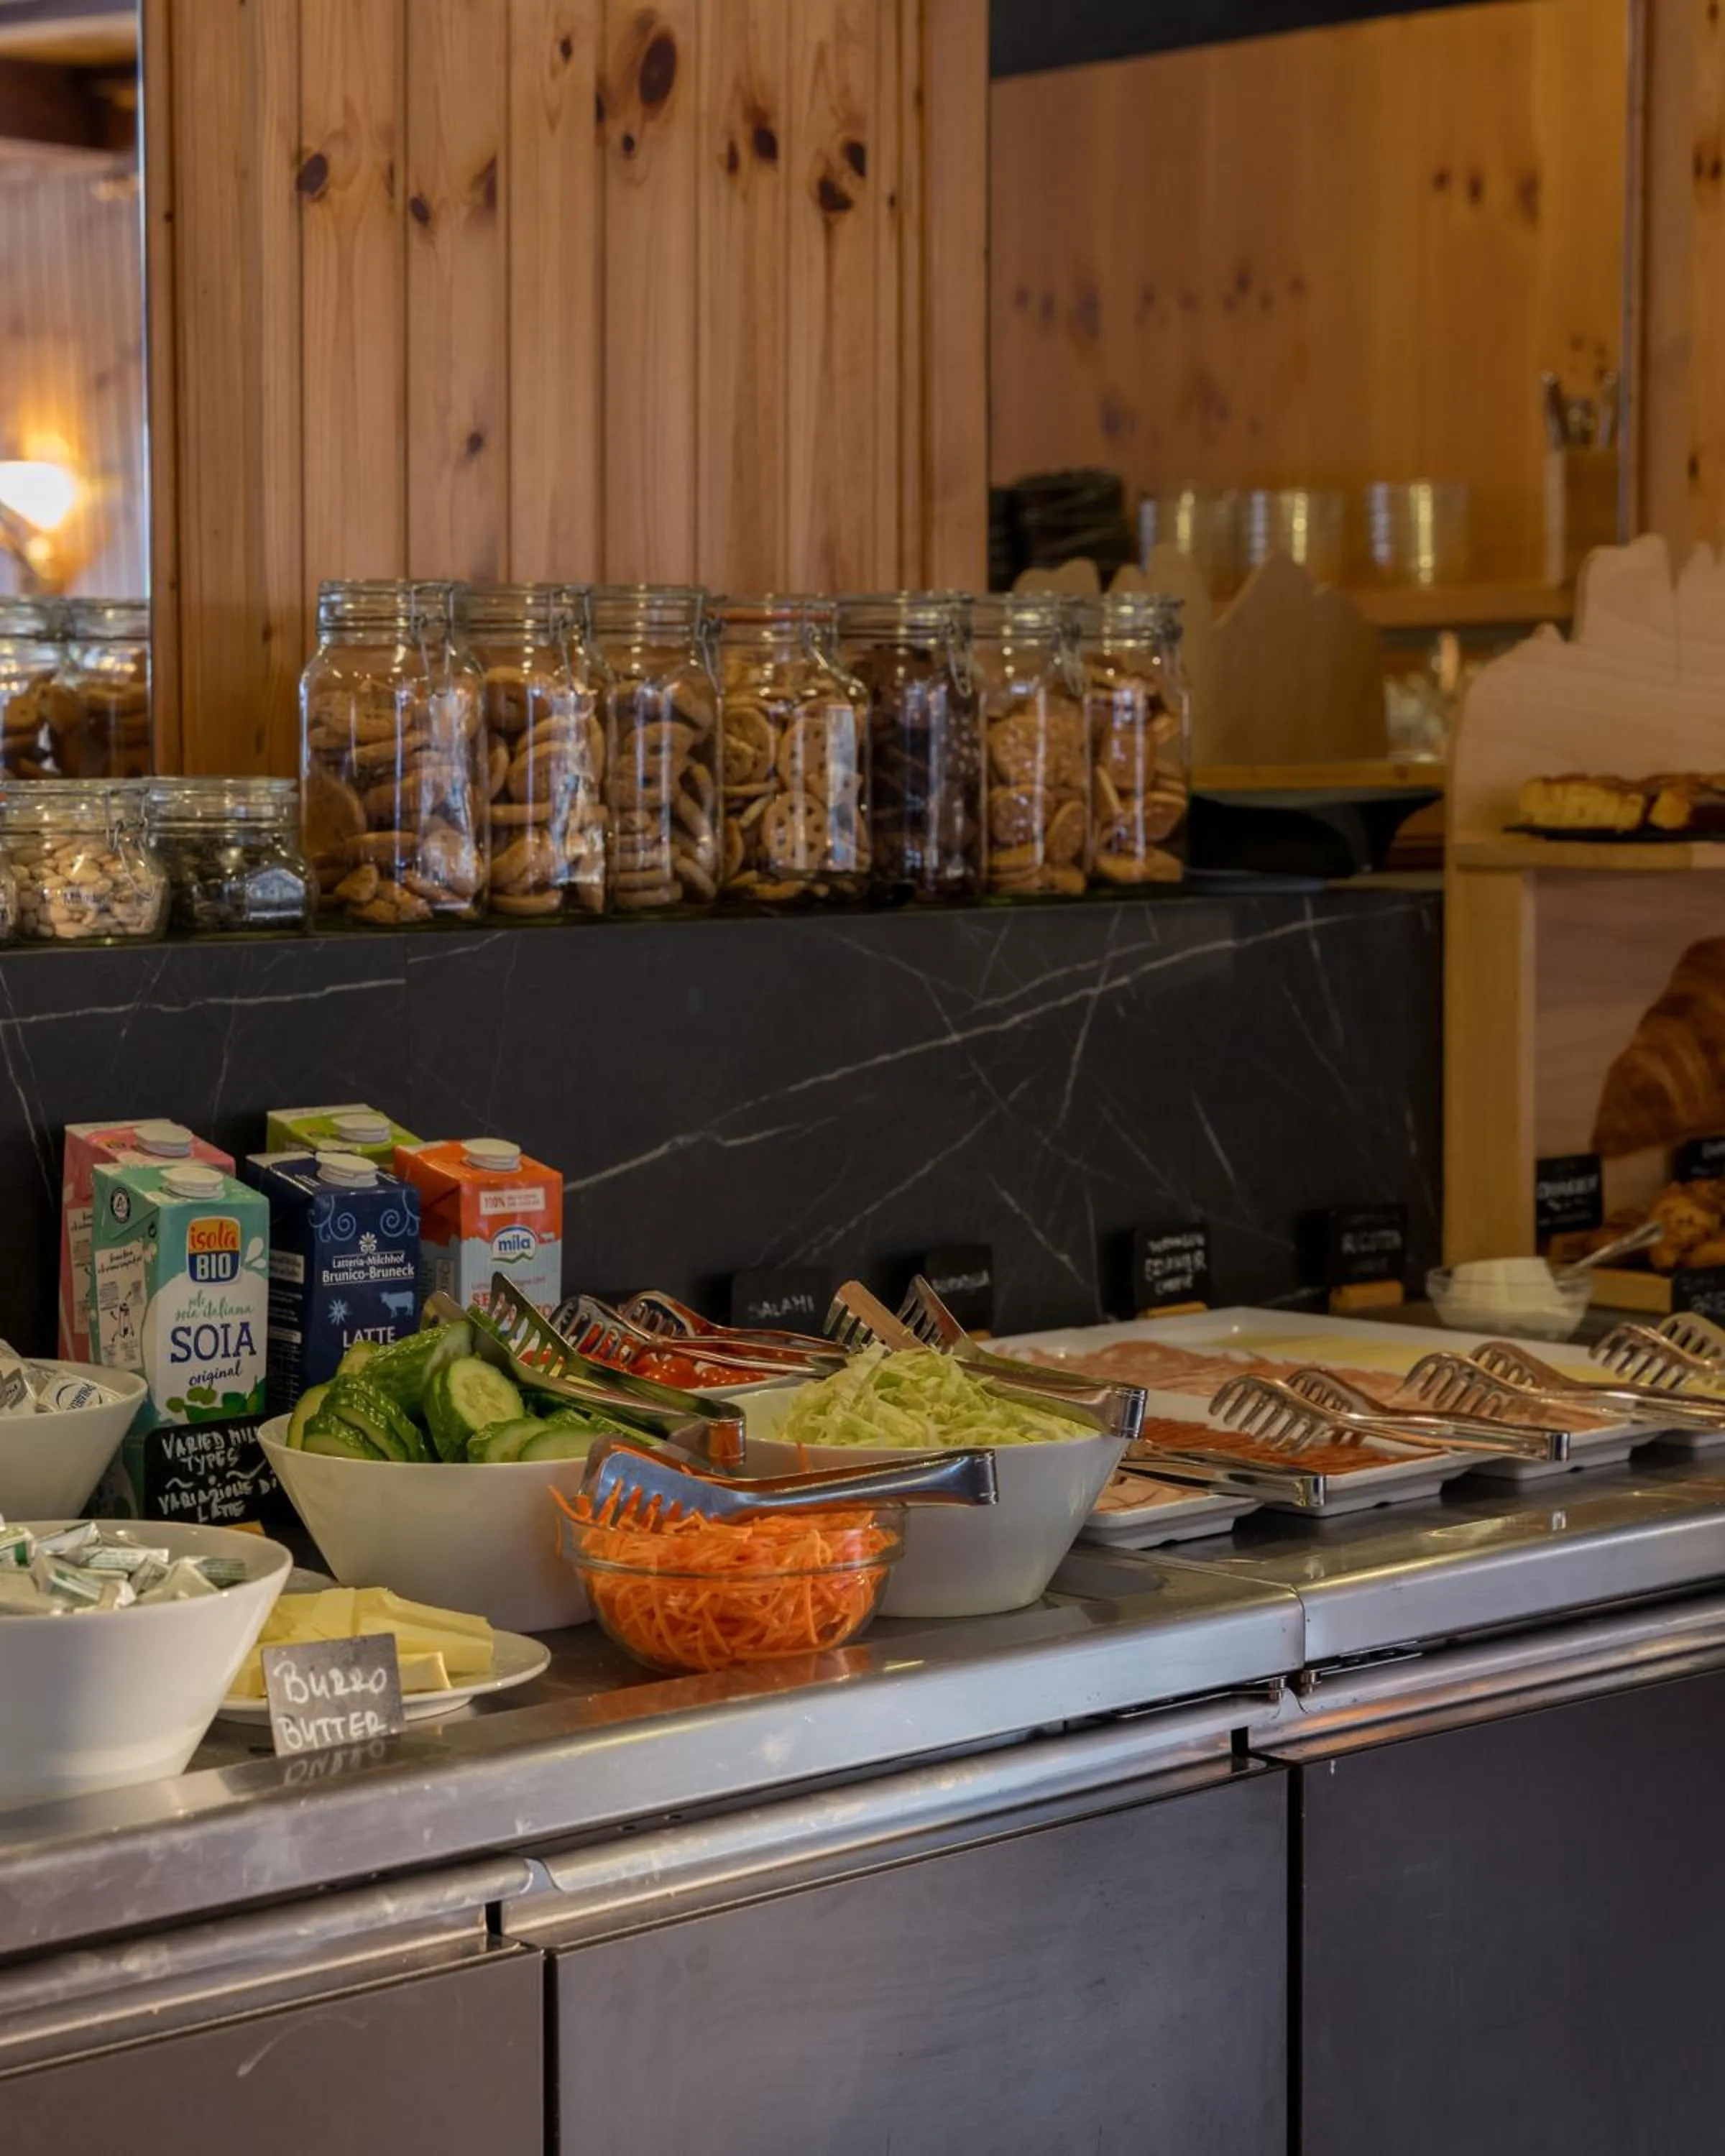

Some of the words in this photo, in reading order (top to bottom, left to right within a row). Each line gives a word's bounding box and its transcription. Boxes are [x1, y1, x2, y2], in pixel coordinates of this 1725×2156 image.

[190, 1221, 237, 1250] isola
[498, 1234, 531, 1251] mila
[196, 1253, 231, 1280] BIO
[322, 1262, 415, 1284] Brunico-Bruneck
[332, 1252, 405, 1269] Latteria-Milchhof
[170, 1322, 257, 1363] SOIA
[343, 1326, 396, 1348] LATTE
[188, 1359, 242, 1388] original
[161, 1431, 226, 1460] VARIED
[180, 1447, 239, 1476] TYPES
[273, 1659, 387, 1704] BURRO
[277, 1710, 387, 1750] BUTTER
